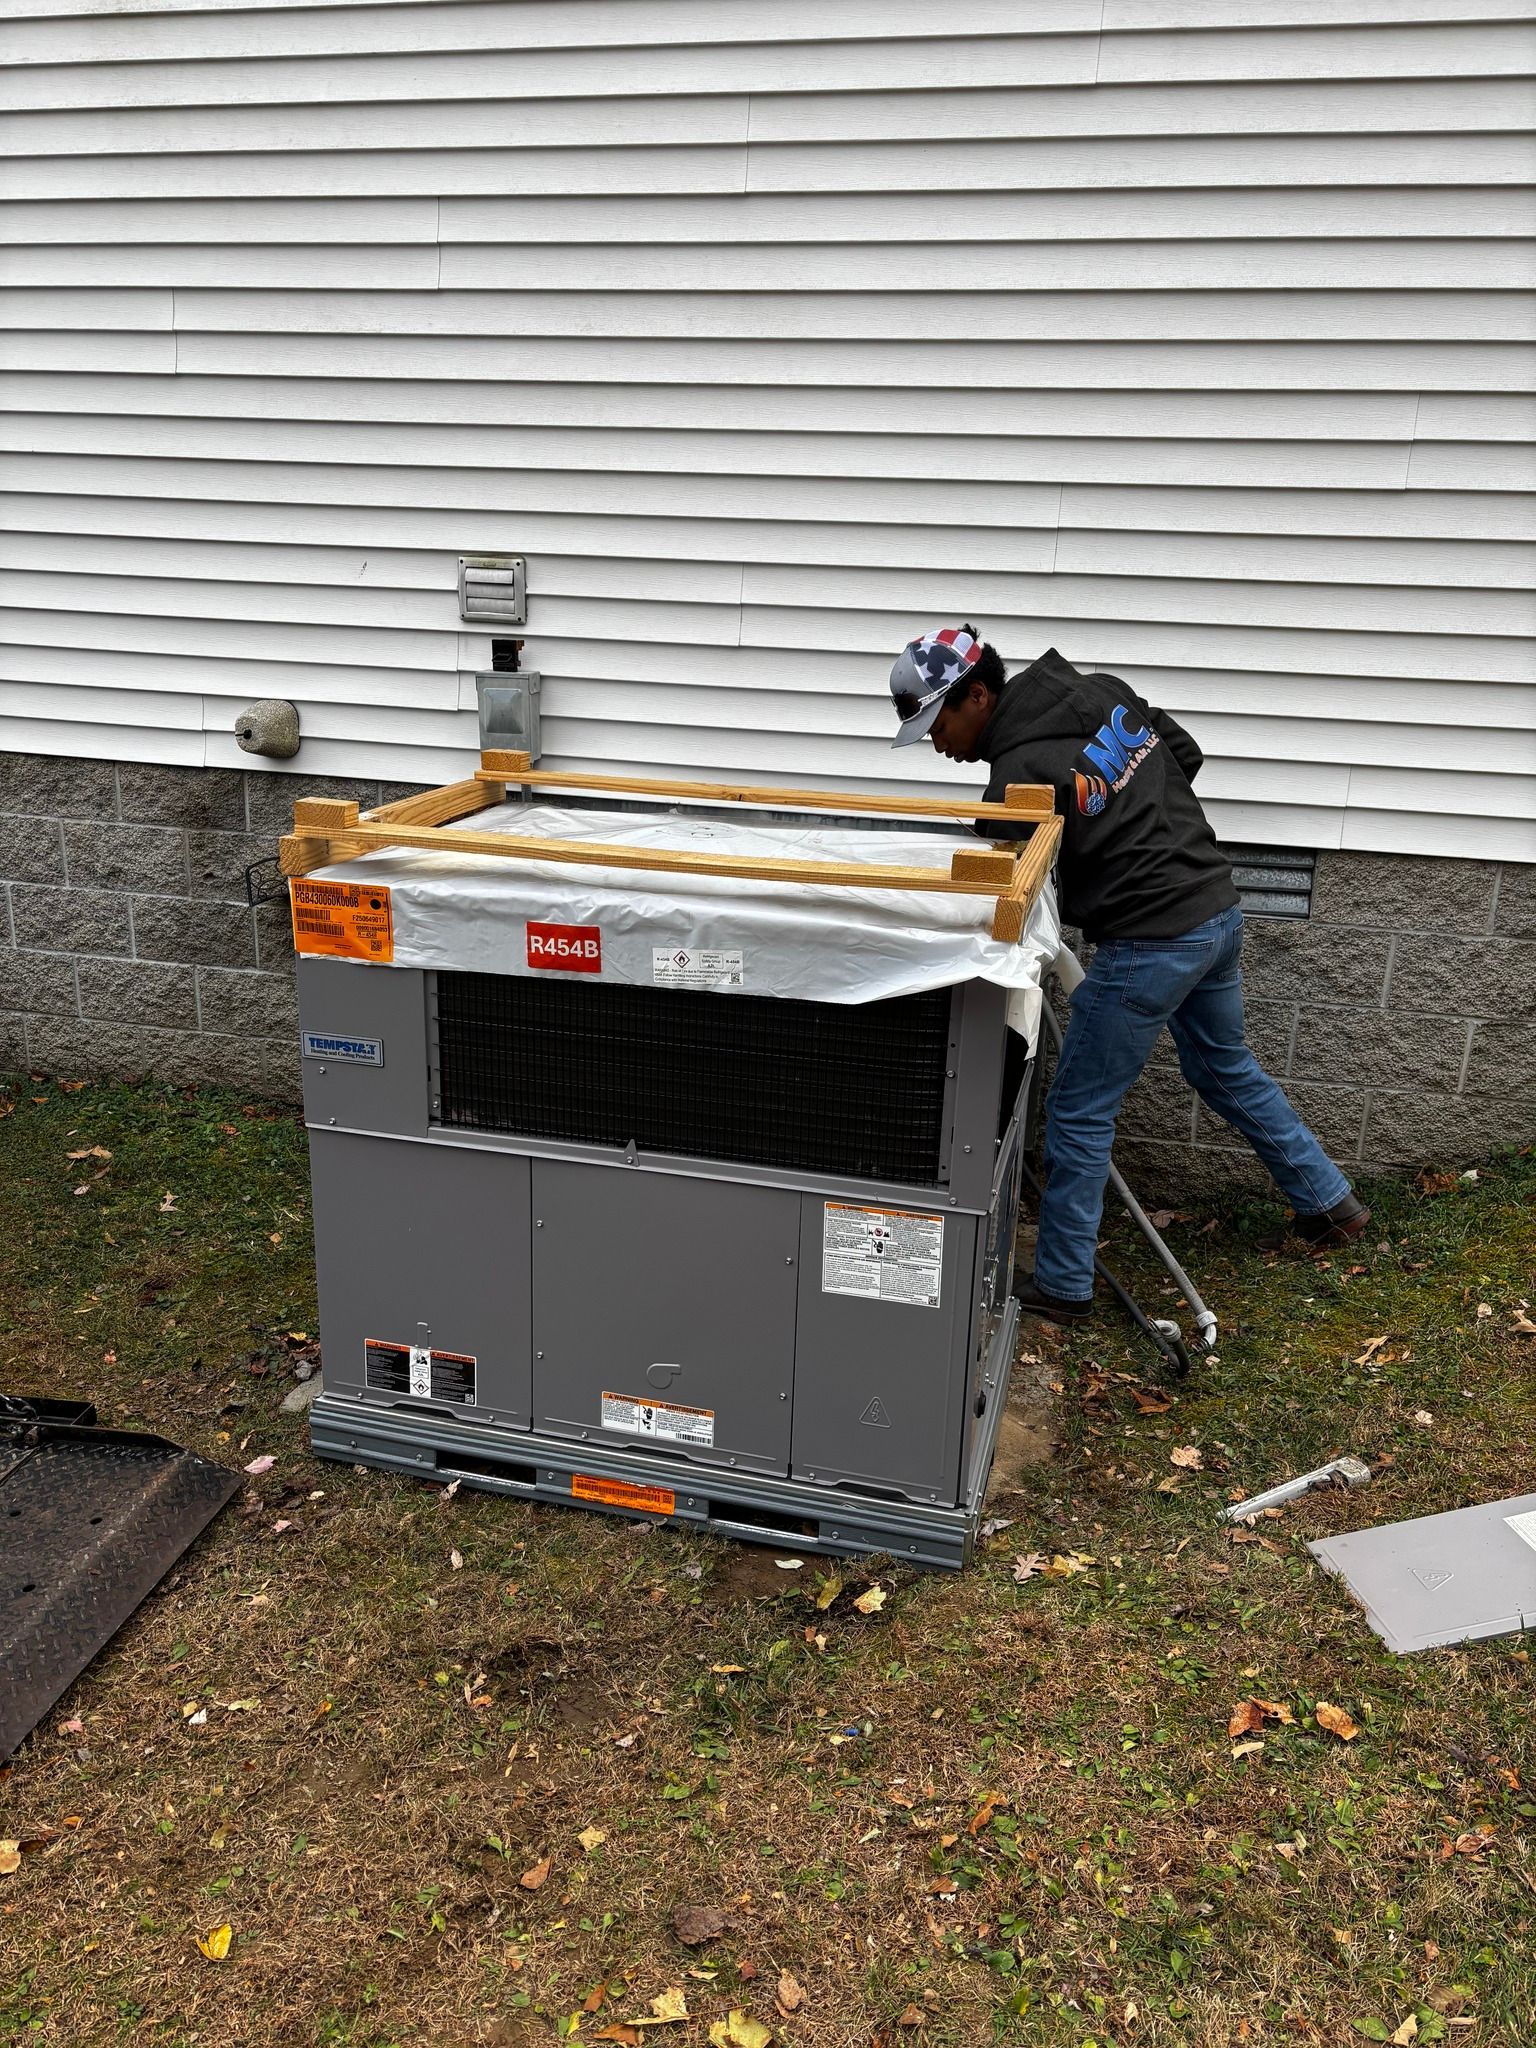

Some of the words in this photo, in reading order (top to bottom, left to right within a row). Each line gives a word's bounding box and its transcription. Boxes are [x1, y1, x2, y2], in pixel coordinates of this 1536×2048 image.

[1129, 759, 1138, 769] &
[1145, 733, 1160, 748] LLC
[530, 935, 599, 958] R454B
[613, 1394, 640, 1404] WARNING
